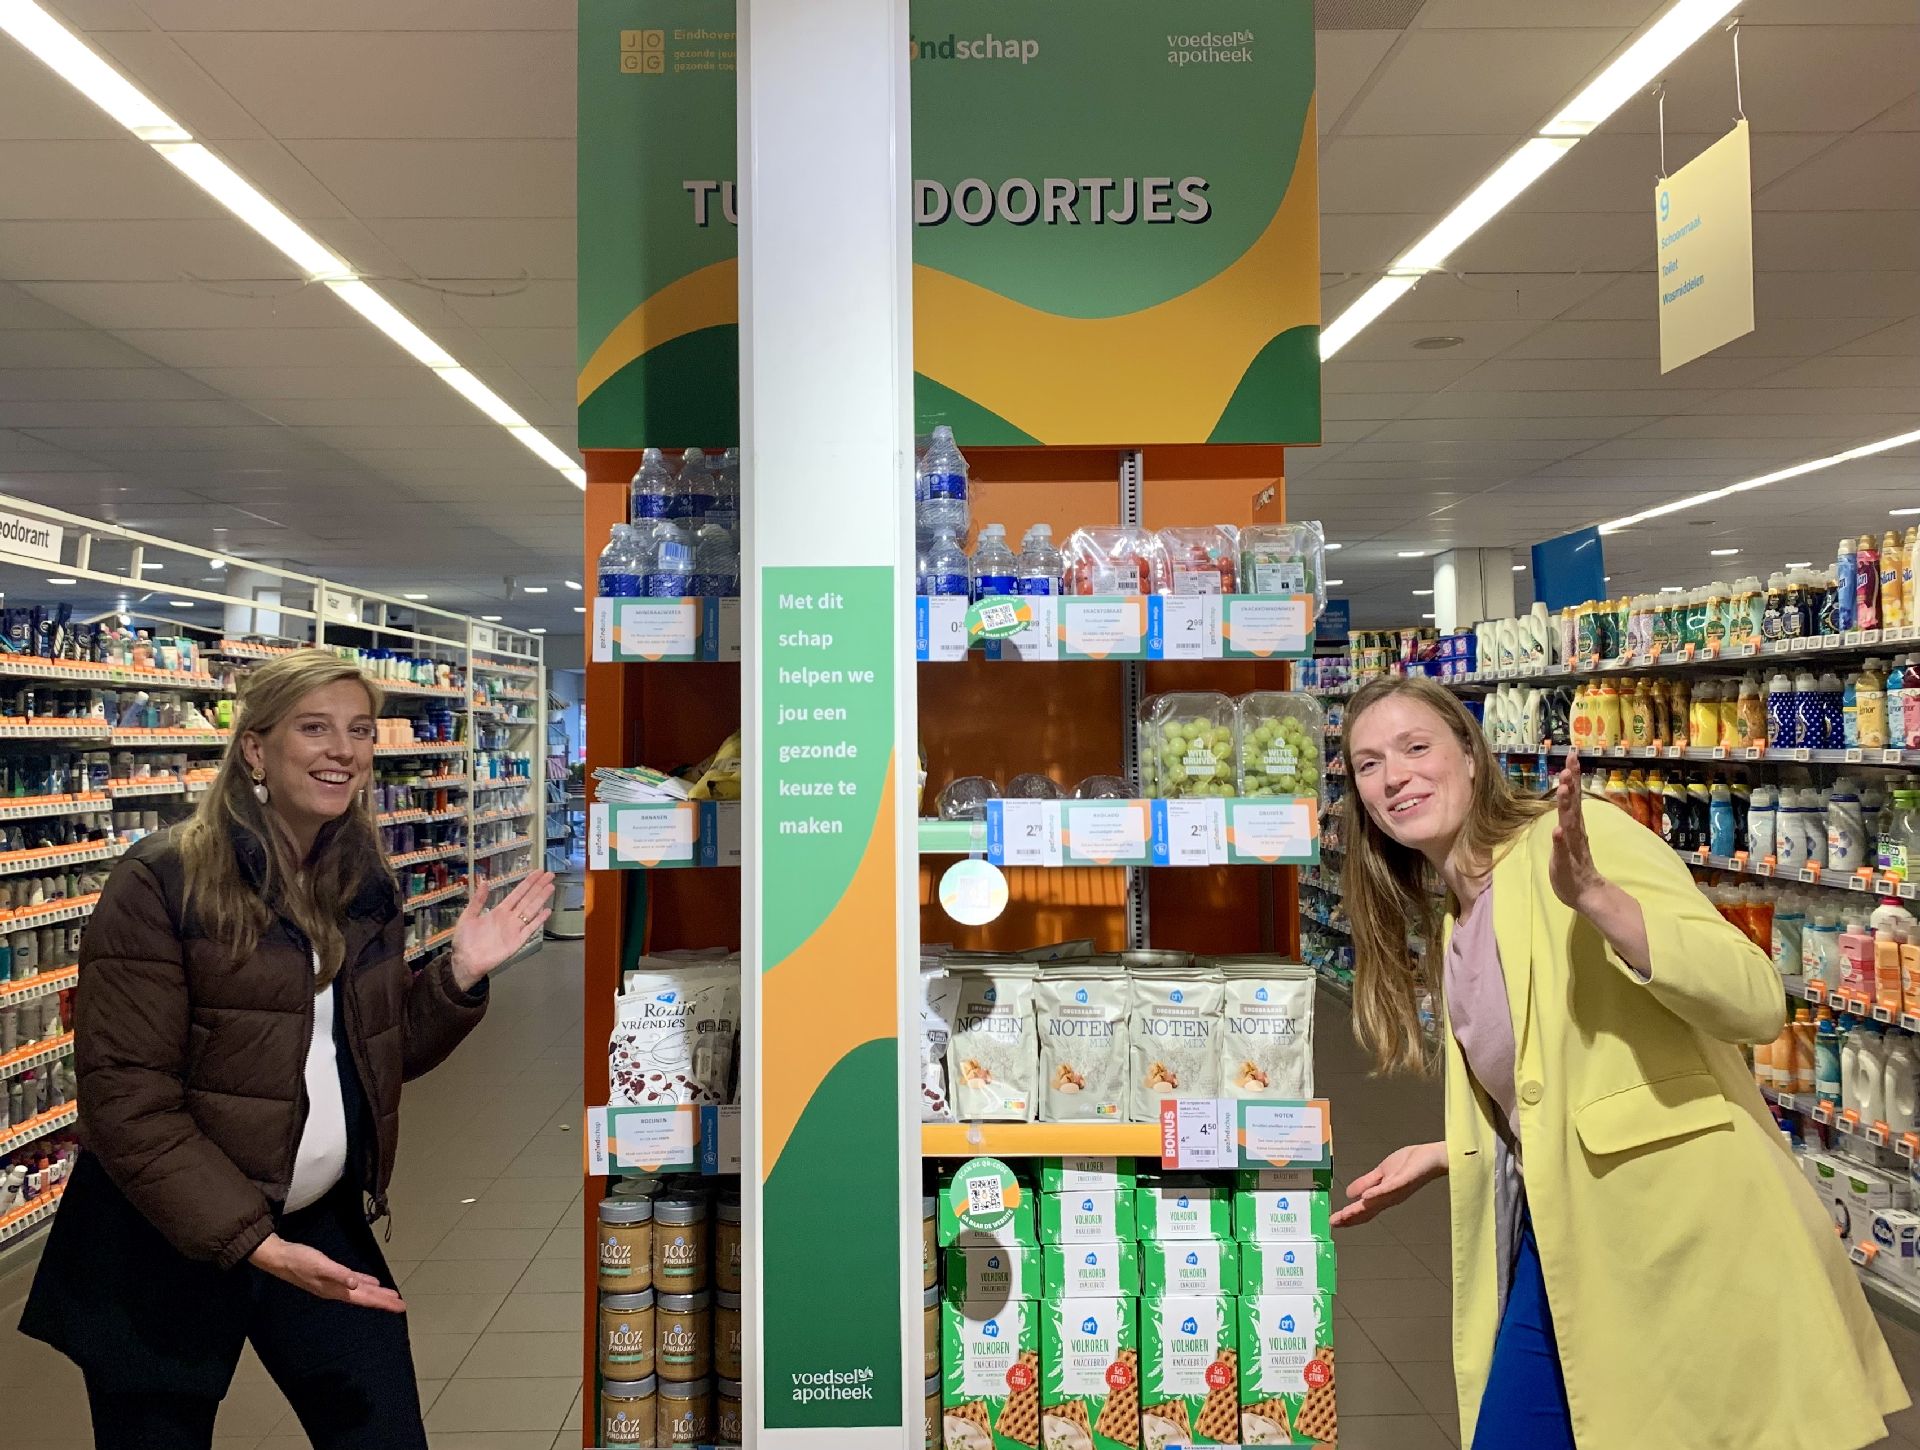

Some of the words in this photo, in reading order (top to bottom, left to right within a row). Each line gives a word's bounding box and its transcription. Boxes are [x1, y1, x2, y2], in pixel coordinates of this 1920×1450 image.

[1167, 31, 1238, 47] voedsel
[1167, 47, 1254, 67] apotheek
[1659, 191, 1670, 222] 9
[778, 593, 813, 609] Met
[818, 593, 844, 609] dit
[778, 630, 834, 650] schap
[779, 667, 843, 687] helpen
[848, 671, 875, 684] we
[777, 704, 808, 725] jou
[813, 707, 847, 721] een
[779, 741, 858, 763] gezonde
[779, 780, 834, 796] keuze
[838, 780, 857, 796] te
[779, 816, 843, 834] maken
[957, 1016, 1023, 1033] NOTEN
[1049, 1019, 1114, 1037] NOTEN
[1142, 1018, 1210, 1037] NOTEN
[1229, 1017, 1297, 1035] NOTEN
[1163, 1110, 1176, 1158] BONUS
[1076, 1161, 1104, 1172] VOLKOREN
[663, 1243, 697, 1259] 100%
[1179, 1268, 1207, 1279] VOLKOREN
[1276, 1266, 1304, 1277] VOLKOREN
[608, 1330, 643, 1345] 100%
[663, 1330, 697, 1345] 100%
[1268, 1336, 1307, 1350] VOLKOREN
[972, 1341, 1010, 1355] VOLKOREN
[1071, 1339, 1109, 1353] VOLKOREN
[1171, 1339, 1209, 1353] VOLKOREN
[606, 1418, 640, 1433] 100%
